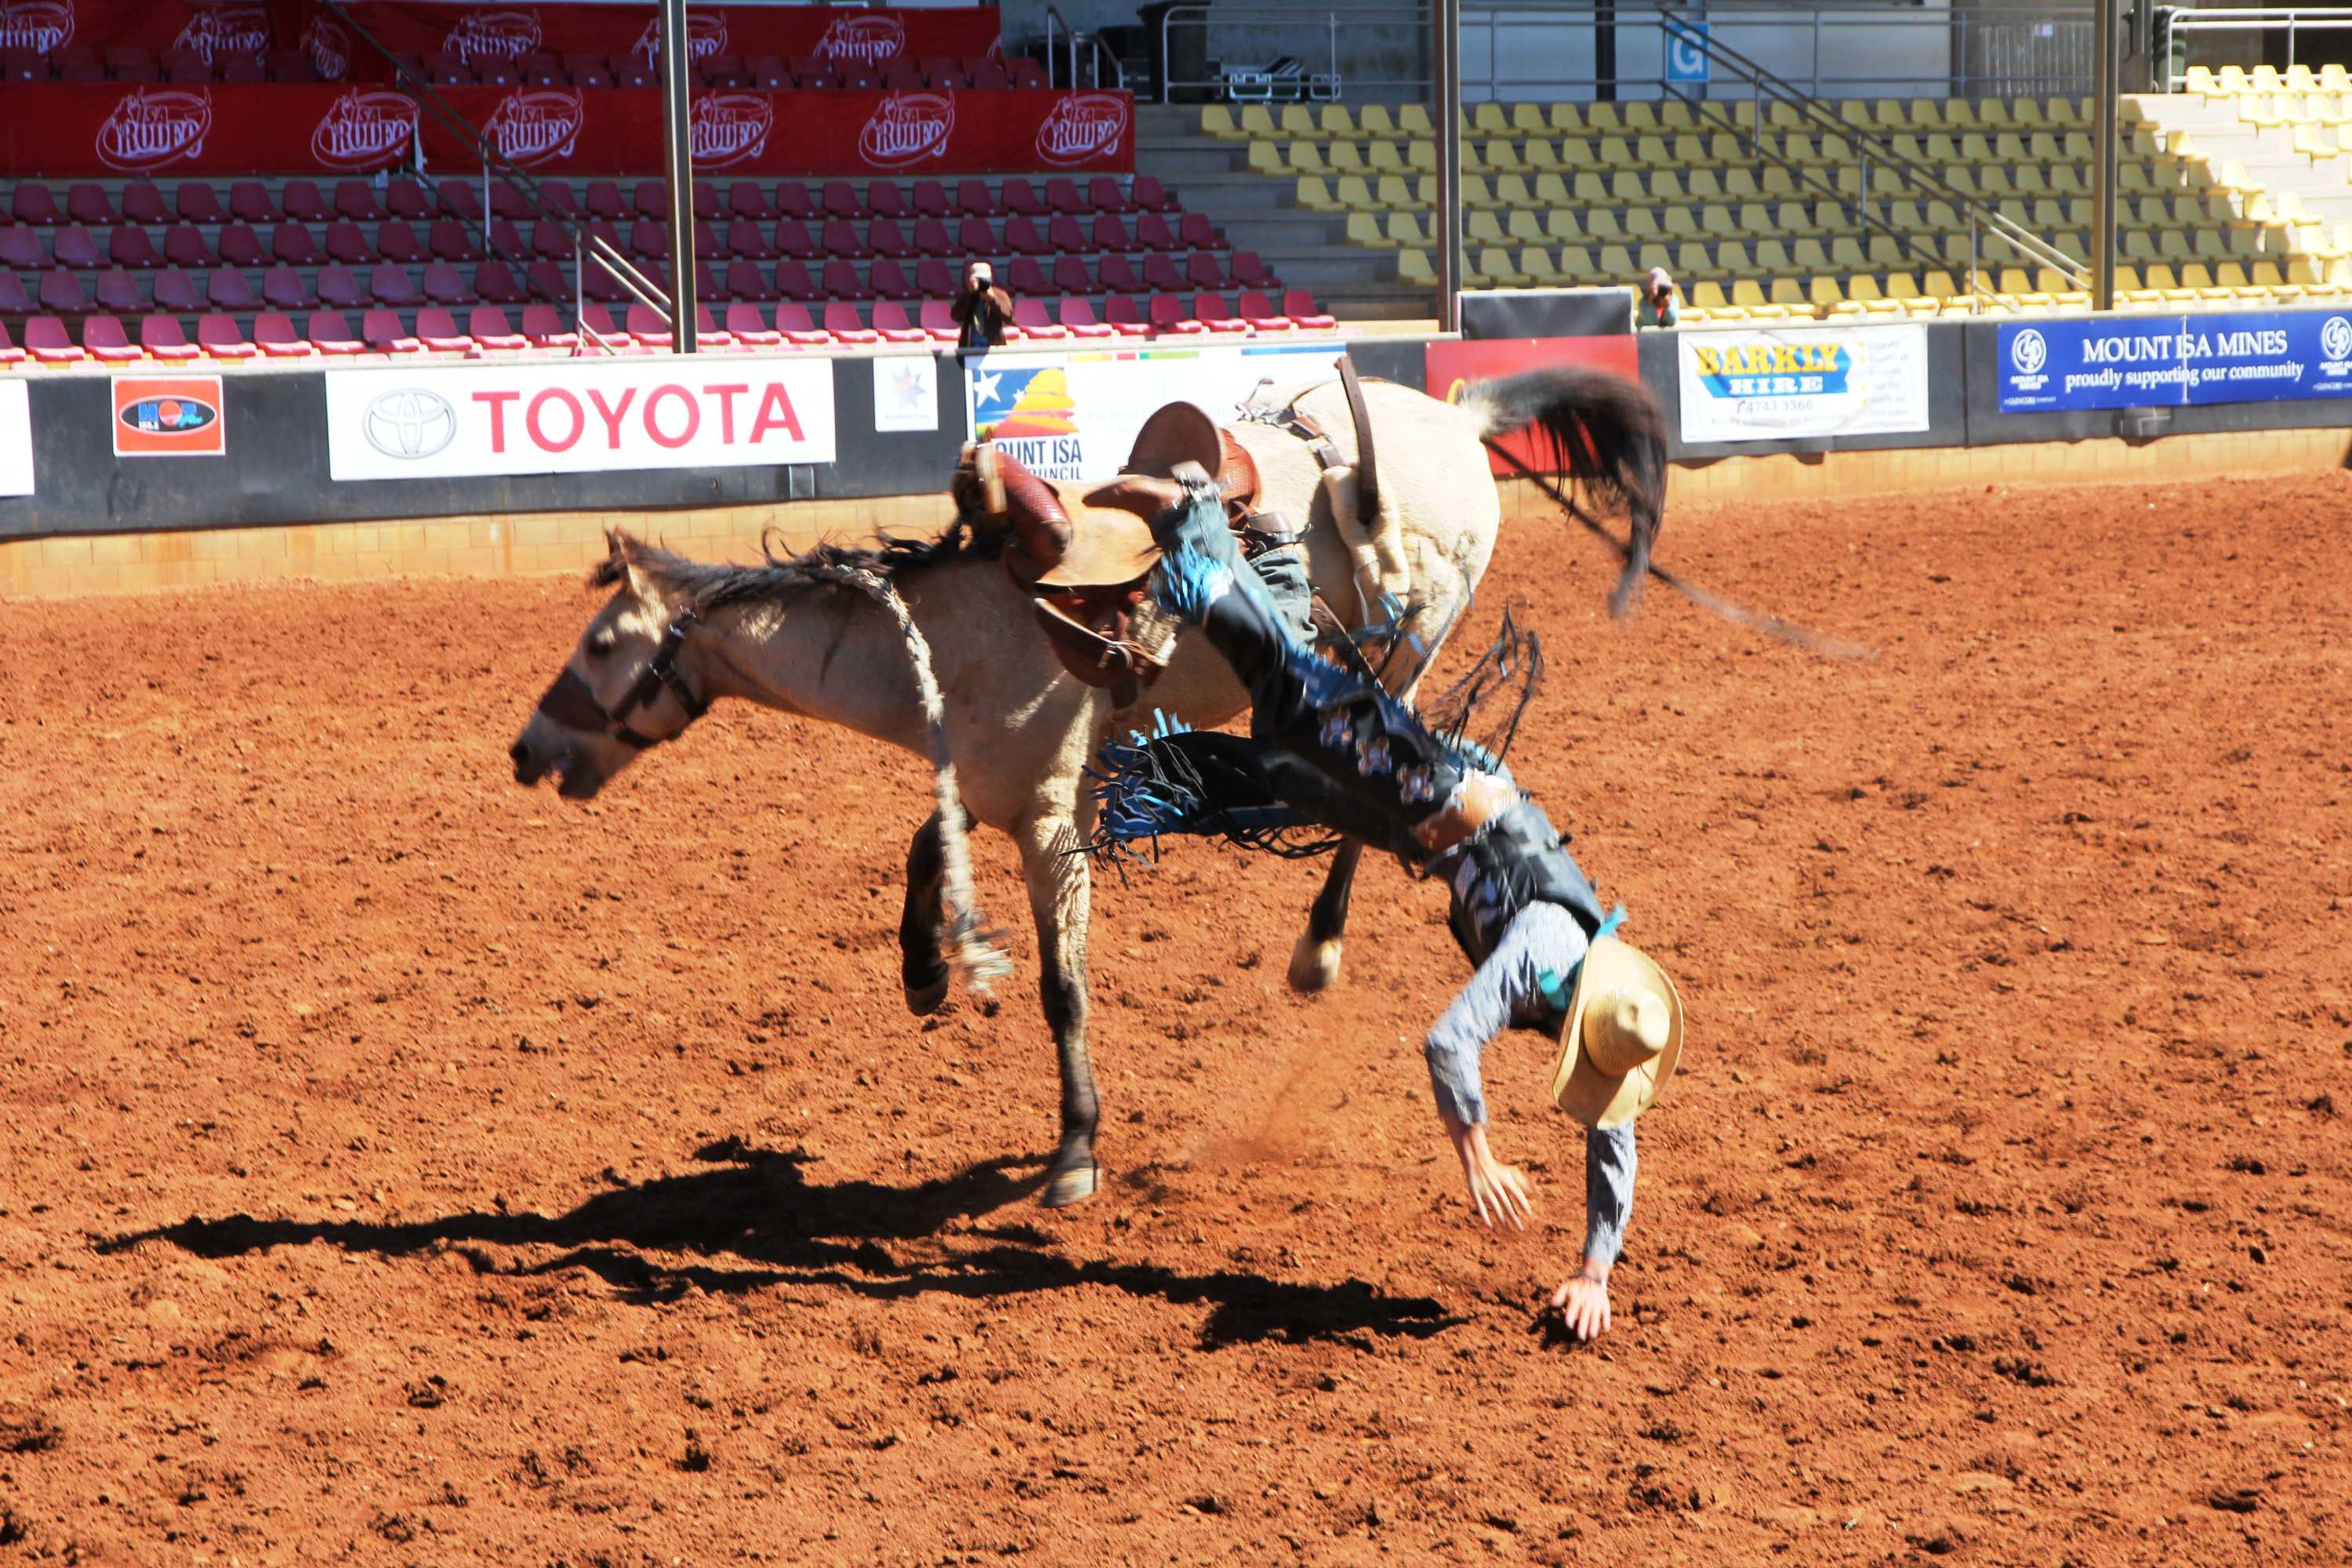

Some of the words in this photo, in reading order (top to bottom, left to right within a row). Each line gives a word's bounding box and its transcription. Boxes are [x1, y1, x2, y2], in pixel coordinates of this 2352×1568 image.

[1673, 30, 1704, 74] G
[1696, 343, 1842, 376] BARKLY
[2082, 335, 2172, 364] MOUNT
[2175, 332, 2212, 359] ISA
[2216, 329, 2288, 357] MINES
[1729, 376, 1823, 395] HIRE
[2064, 367, 2123, 394] proudly
[2125, 365, 2200, 390] supporting
[2201, 365, 2227, 382] our
[2228, 360, 2305, 383] community
[472, 382, 806, 453] TOYOTA
[994, 441, 1047, 465] OUNT
[1052, 438, 1083, 464] ISA
[1028, 466, 1083, 481] OUNCIL
